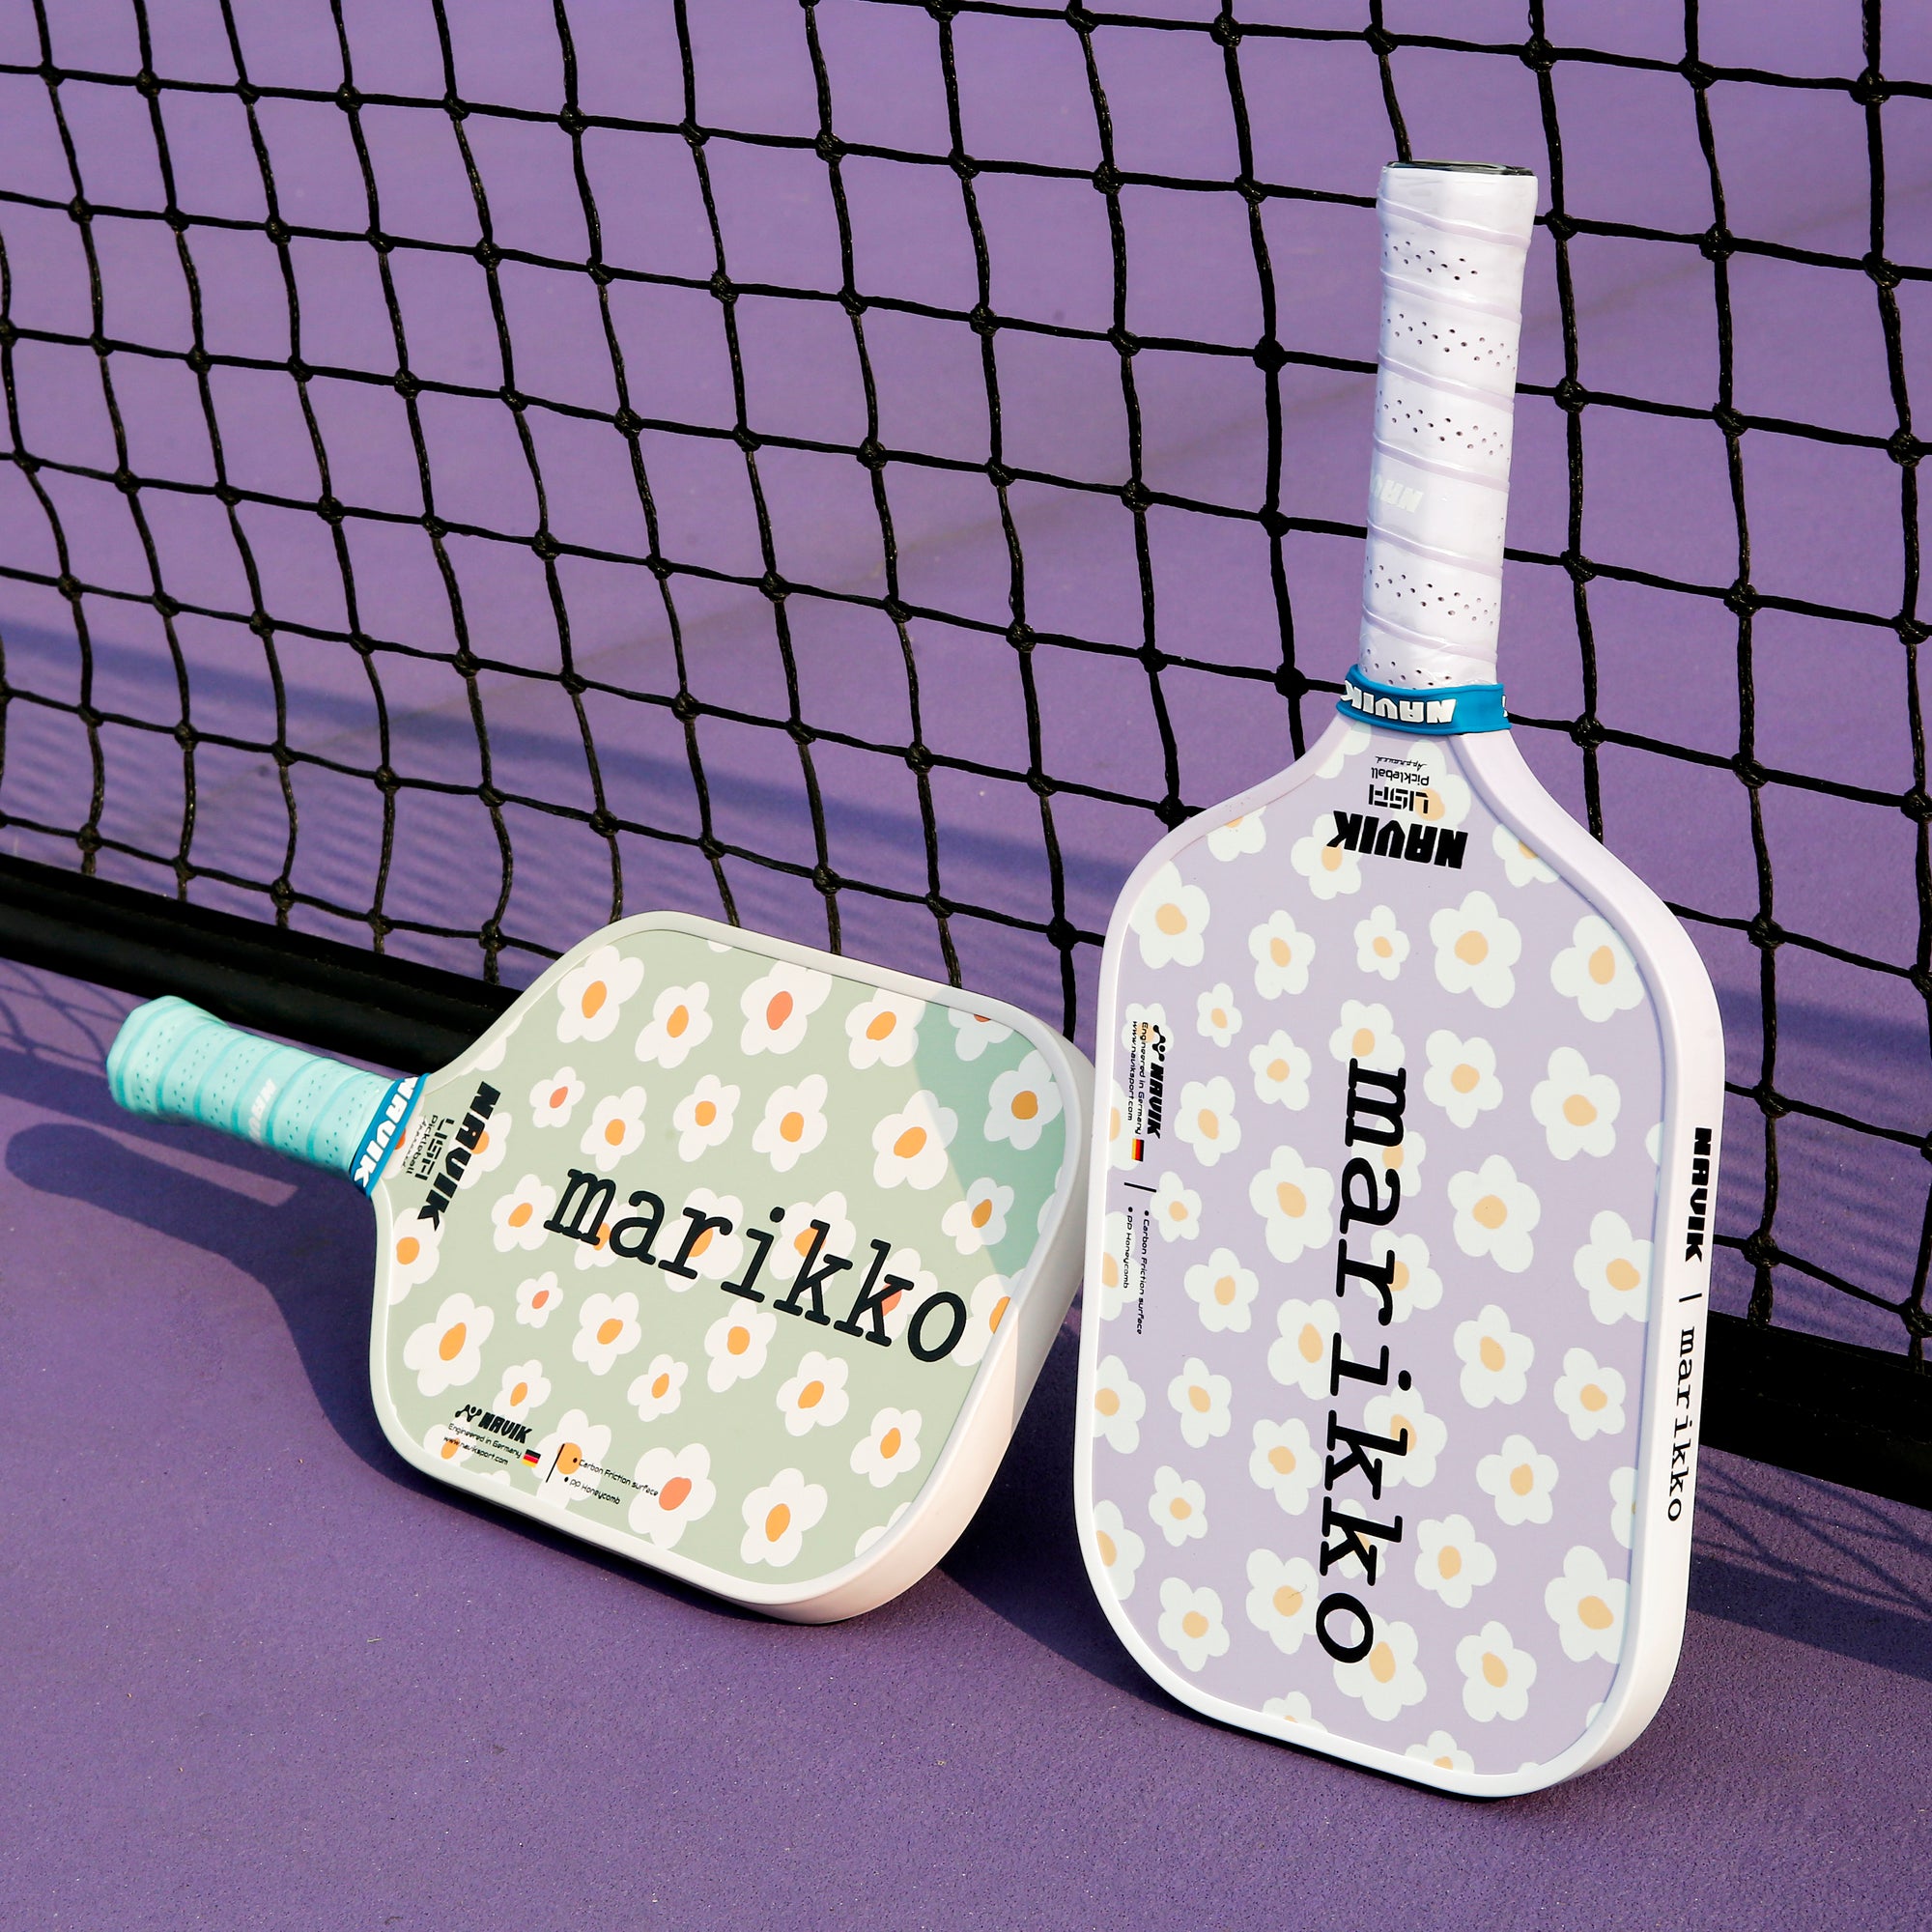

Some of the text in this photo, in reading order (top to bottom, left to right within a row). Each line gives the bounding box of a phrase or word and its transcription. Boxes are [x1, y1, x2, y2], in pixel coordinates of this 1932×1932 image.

[1341, 680, 1457, 724] NAVIK
[1371, 767, 1430, 786] Pickleball
[1375, 755, 1427, 772] Approved
[1368, 783, 1429, 814] USA
[1327, 810, 1468, 869] NAVIK
[1127, 1021, 1138, 1122] www.naviksport.com
[1135, 1021, 1149, 1135] Engineered in Germany
[1148, 1063, 1164, 1140] NAVIK
[354, 1076, 419, 1187] NAVIK
[406, 1114, 439, 1174] Pickleball
[414, 1118, 455, 1180] USA
[417, 1081, 501, 1232] NAVIK
[543, 1168, 967, 1362] marikko
[1122, 1233, 1131, 1289] Honeycomb
[1136, 1218, 1150, 1335] Carbon Friction surface
[1667, 1126, 1713, 1522] NAVIK marikko
[1316, 1057, 1412, 1664] marikko
[442, 1435, 509, 1465] www.naviksport.com
[447, 1423, 523, 1460] Engineered in Germany
[478, 1411, 532, 1444] NAVIK
[578, 1459, 660, 1496] Carbon Friction surface
[582, 1482, 621, 1505] Honeycomb
